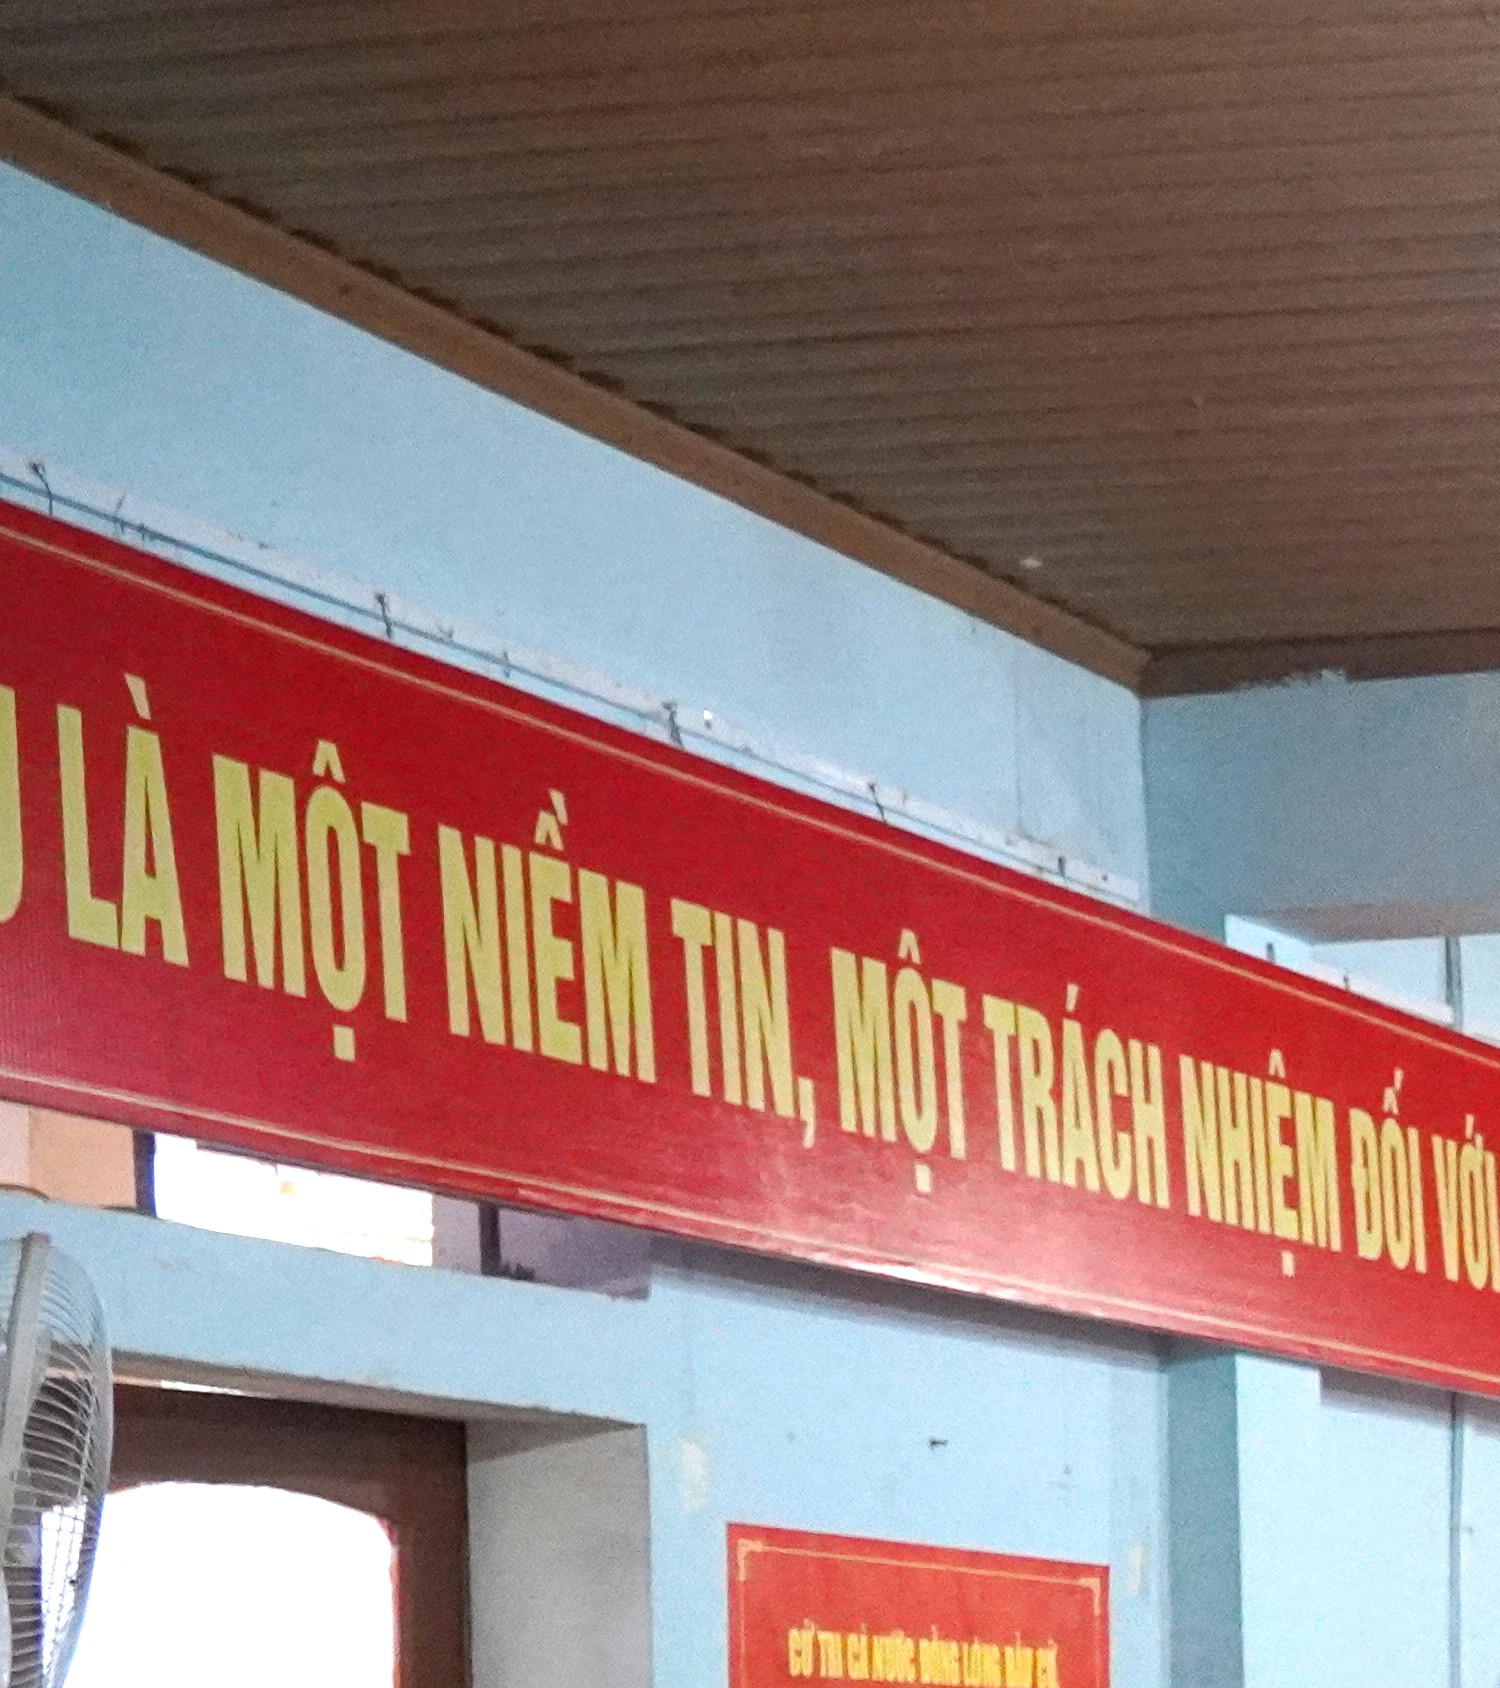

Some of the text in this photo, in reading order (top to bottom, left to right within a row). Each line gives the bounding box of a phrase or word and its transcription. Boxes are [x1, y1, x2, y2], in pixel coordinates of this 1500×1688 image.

[56, 673, 189, 967] LÀ
[212, 740, 409, 1062] MỘT
[437, 790, 656, 1083] NIỀM
[672, 898, 816, 1148] TIN,
[831, 928, 966, 1193] MỘT
[983, 984, 1170, 1209] TRÁCH
[1179, 1049, 1341, 1278] NHIỆM
[1350, 1071, 1427, 1273] ĐỐI
